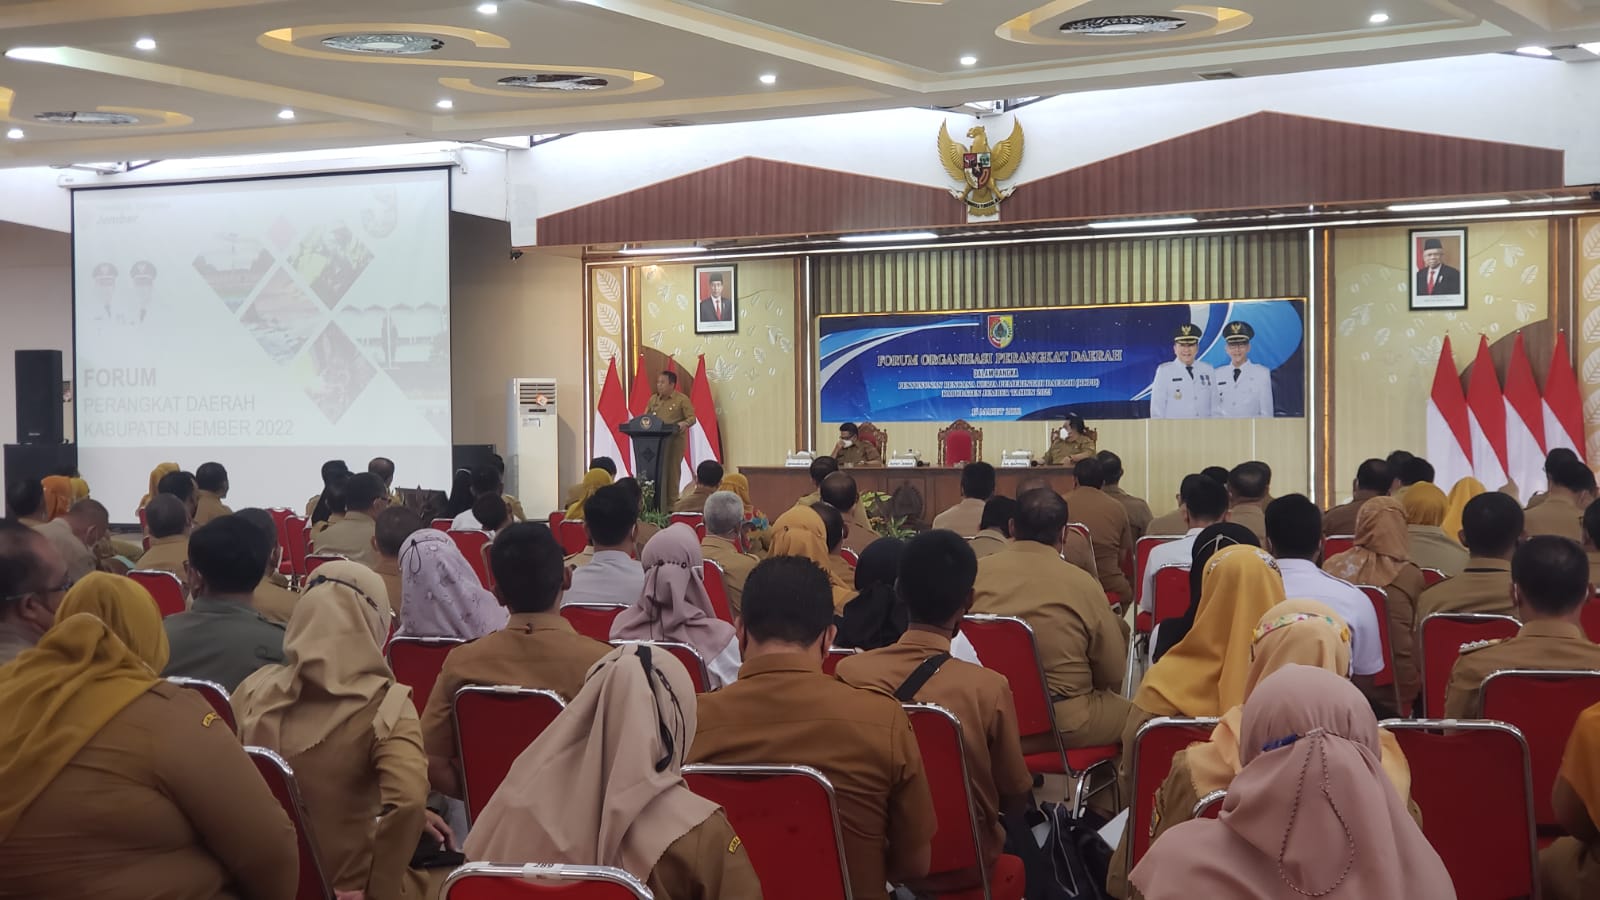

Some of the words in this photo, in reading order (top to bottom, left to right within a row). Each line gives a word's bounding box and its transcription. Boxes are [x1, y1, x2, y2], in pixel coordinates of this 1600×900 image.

[877, 354, 918, 367] FORUM
[995, 351, 1069, 363] PERANGKAT
[1071, 349, 1123, 362] DAERAH
[83, 367, 157, 388] FORUM
[83, 396, 183, 413] PERANGKAT
[186, 395, 255, 412] DAERAH
[83, 420, 179, 438] KABUPATEN
[184, 420, 251, 437] JEMBER
[256, 419, 294, 437] 2022
